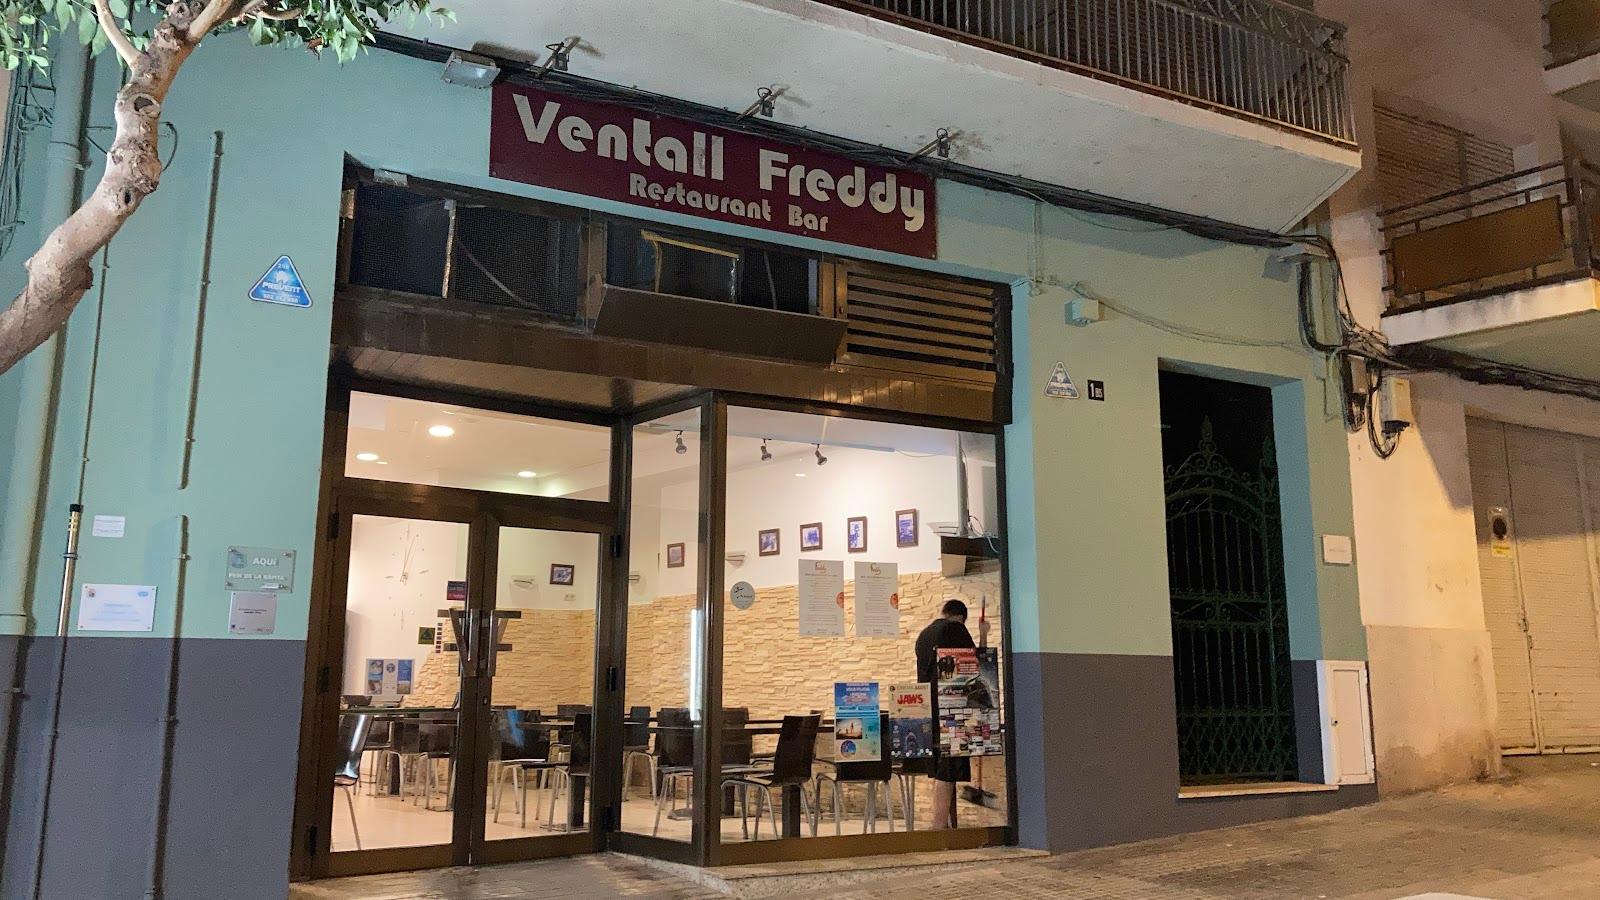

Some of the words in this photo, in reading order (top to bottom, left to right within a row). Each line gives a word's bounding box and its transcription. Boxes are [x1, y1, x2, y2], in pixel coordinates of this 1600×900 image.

[512, 93, 724, 181] Ventall
[759, 148, 925, 232] Freddy
[629, 172, 772, 222] Restaurant
[788, 204, 829, 232] Bar
[262, 281, 301, 293] PREVENT
[1090, 382, 1095, 398] 1
[897, 693, 924, 705] JAWS
